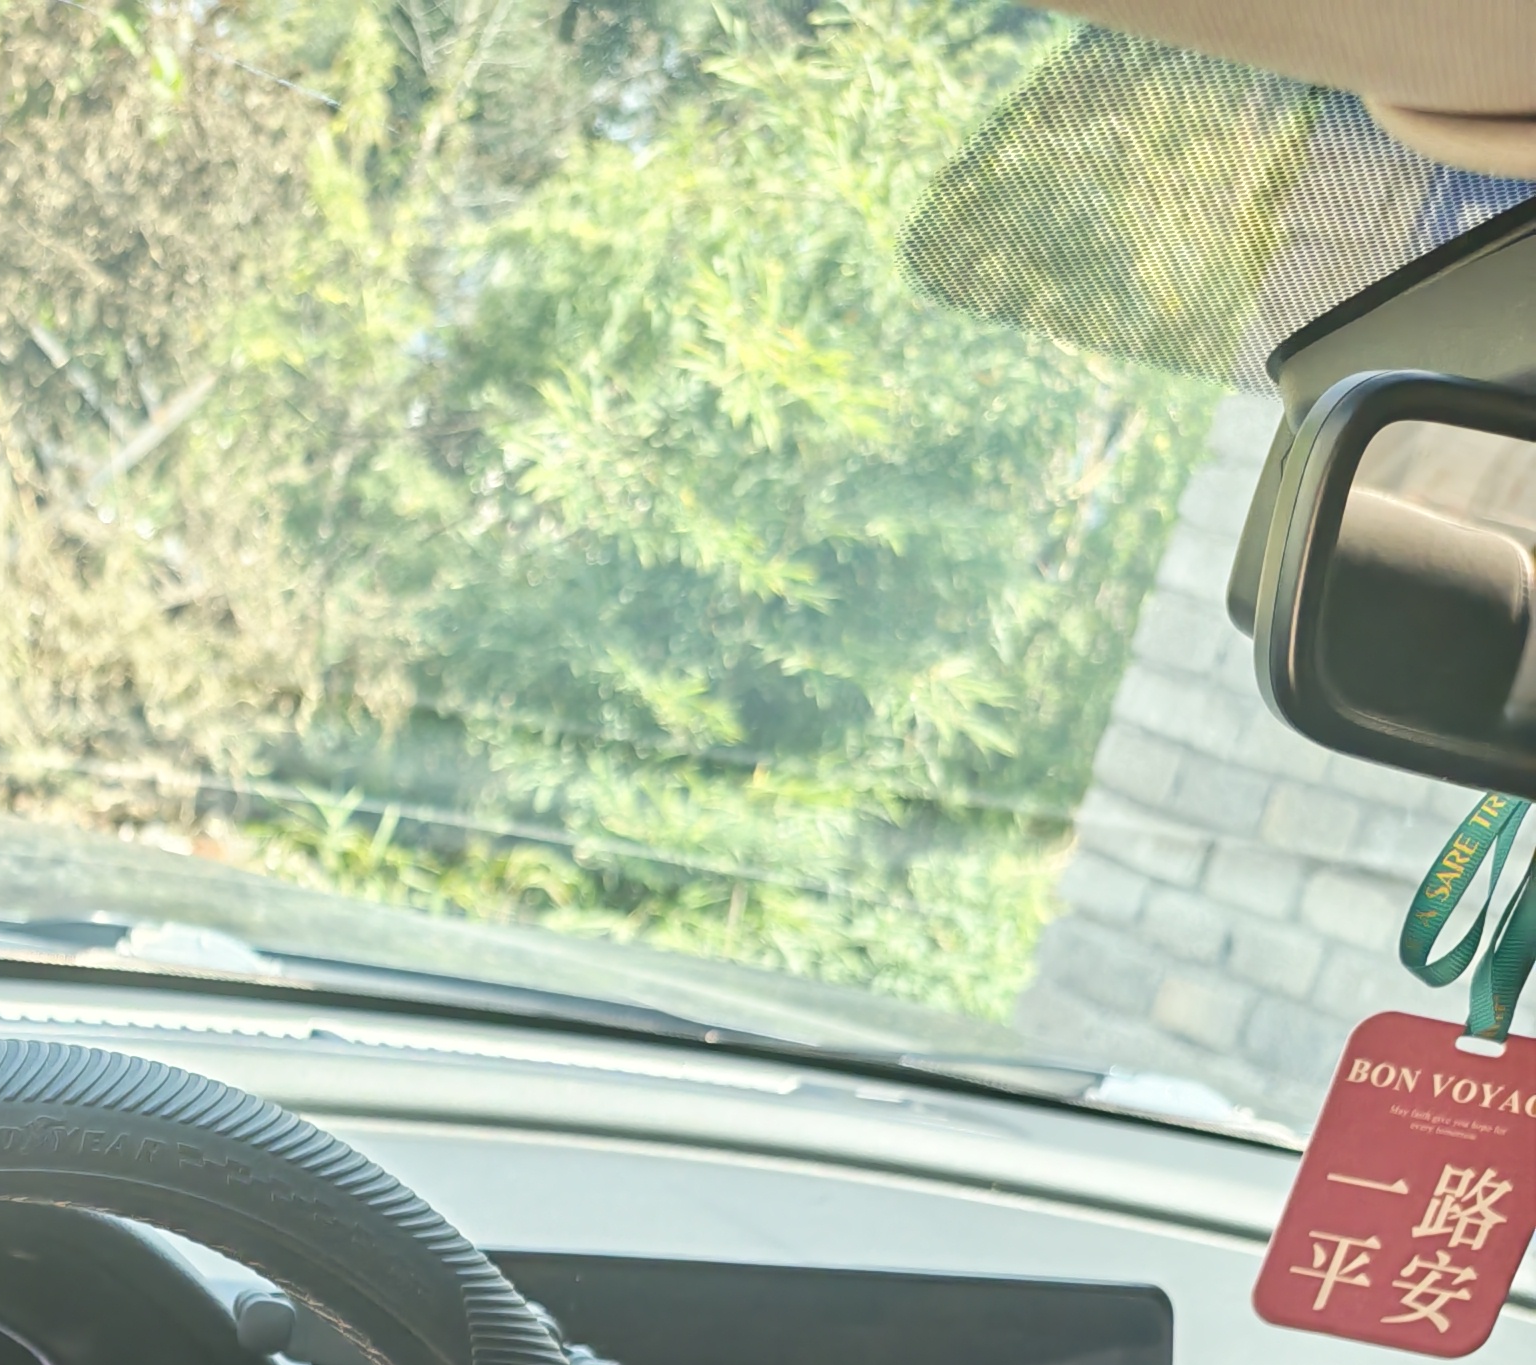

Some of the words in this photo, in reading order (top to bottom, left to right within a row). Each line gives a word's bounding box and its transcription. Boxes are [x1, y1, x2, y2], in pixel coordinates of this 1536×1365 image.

[1425, 833, 1480, 903] SARE
[1345, 1058, 1422, 1093] BON
[1326, 1164, 1513, 1250] 一路
[1289, 1229, 1478, 1334] 平安
